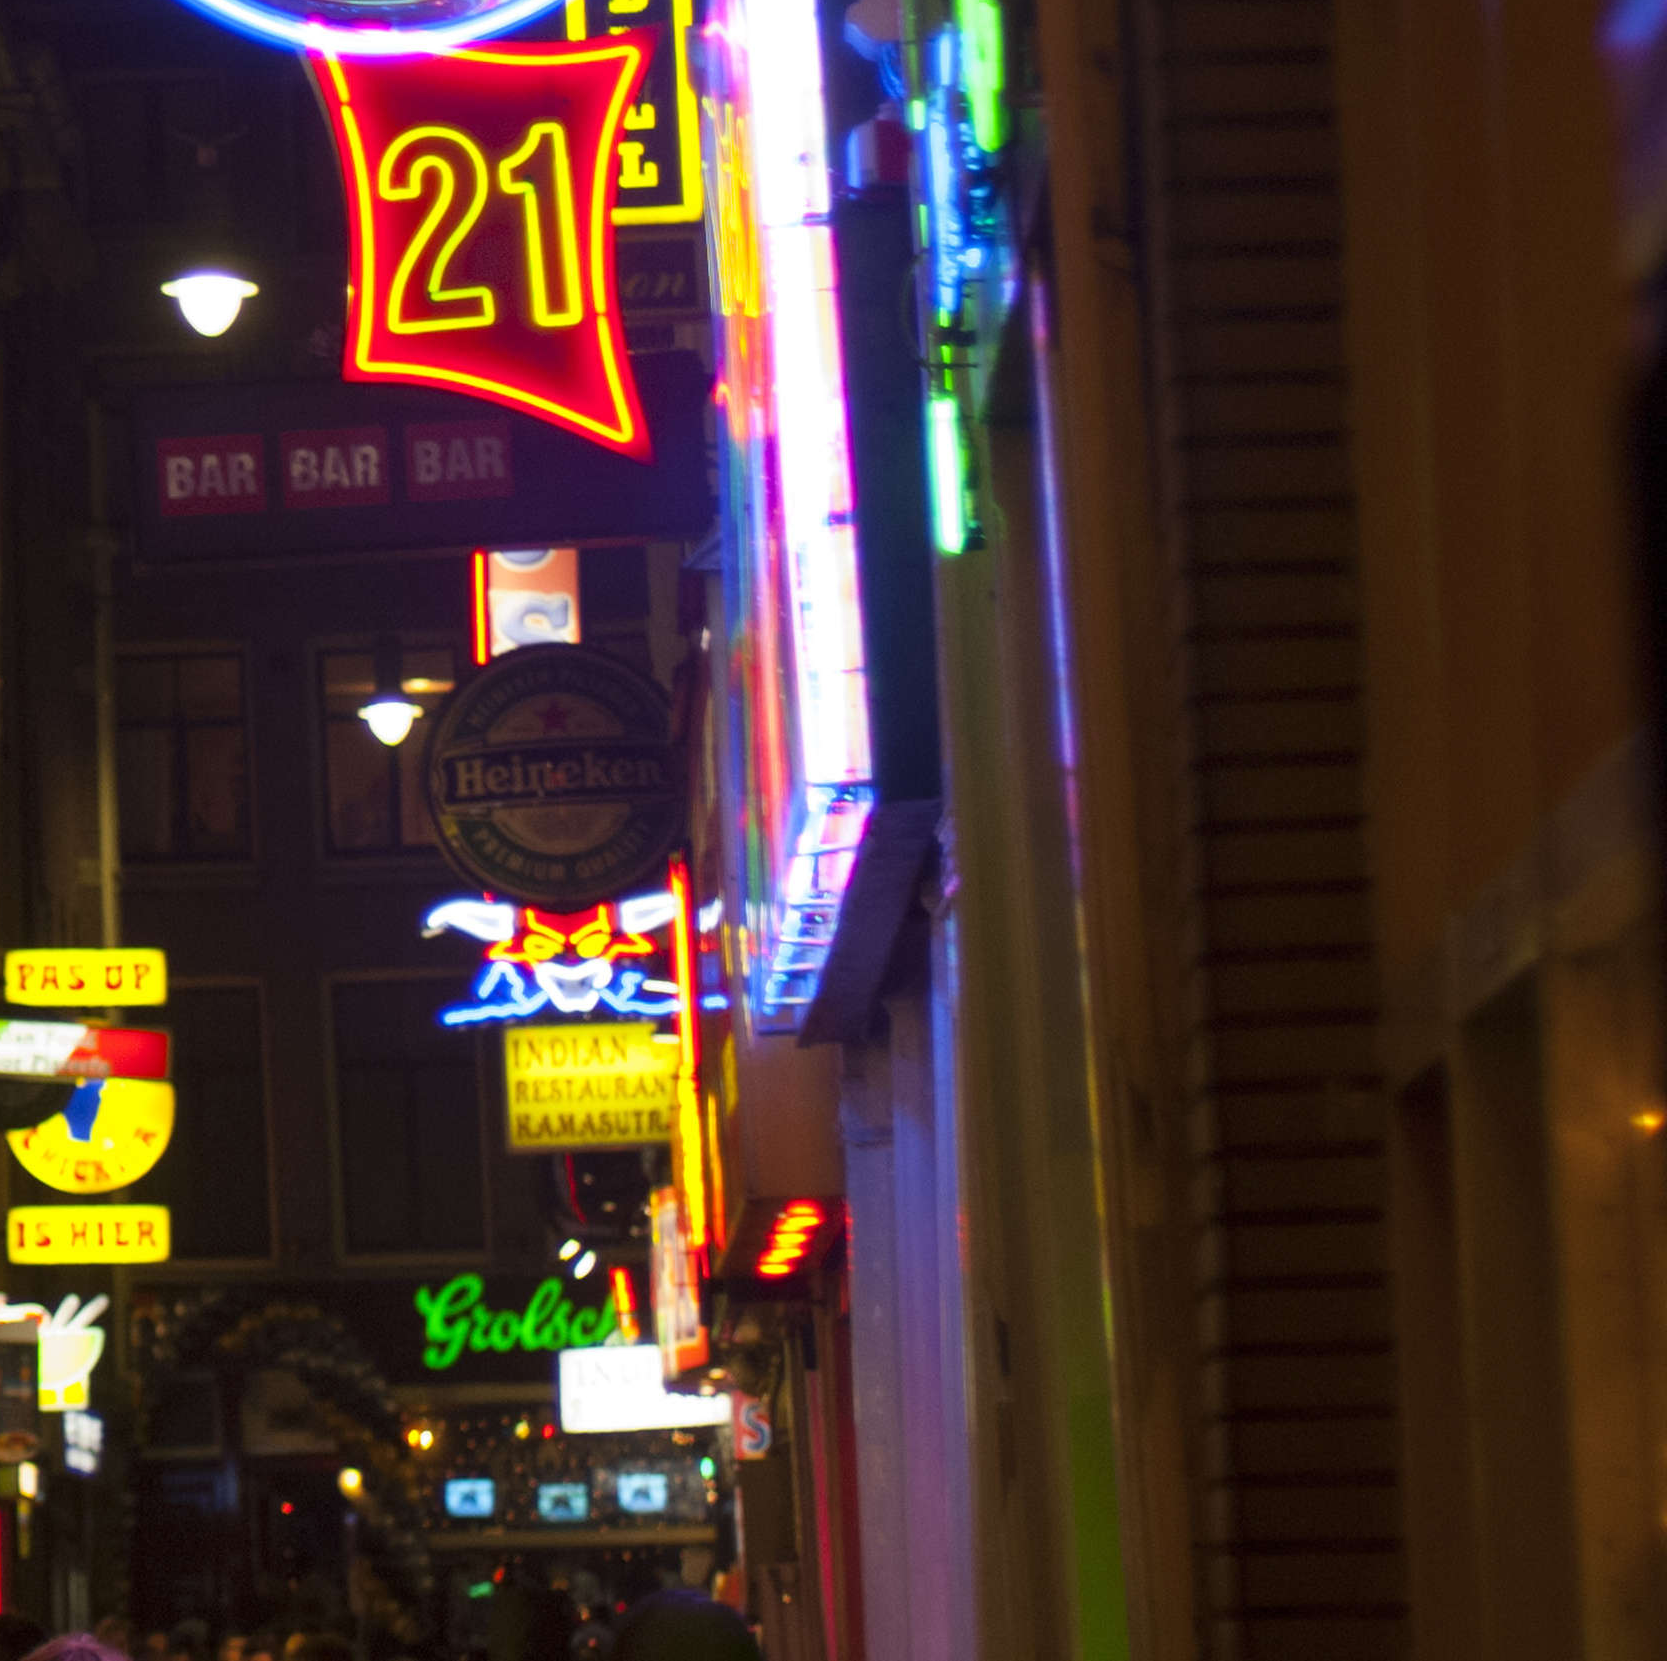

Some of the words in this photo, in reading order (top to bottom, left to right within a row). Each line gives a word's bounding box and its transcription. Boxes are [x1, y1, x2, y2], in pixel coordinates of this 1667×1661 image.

[378, 122, 583, 336] 21
[167, 452, 258, 500] BAR
[290, 444, 380, 492] BAR
[413, 436, 506, 485] BAR
[454, 750, 664, 801] Heineken
[17, 963, 86, 991] PAS
[511, 1034, 628, 1070] INDIAN
[514, 1074, 669, 1105] RESTAURAN
[515, 1110, 672, 1140] KAMASUTR
[17, 1221, 52, 1248] IS
